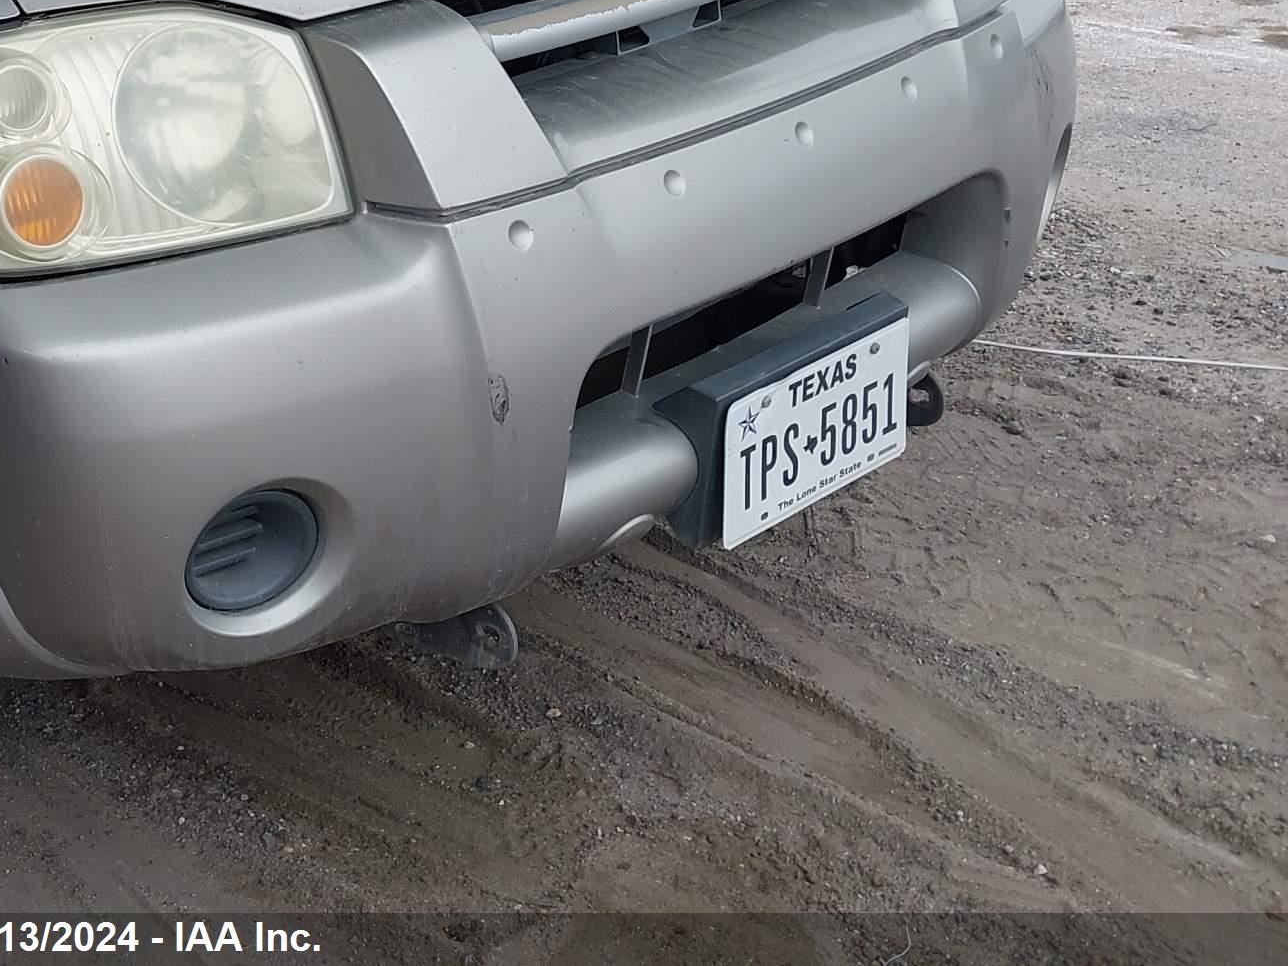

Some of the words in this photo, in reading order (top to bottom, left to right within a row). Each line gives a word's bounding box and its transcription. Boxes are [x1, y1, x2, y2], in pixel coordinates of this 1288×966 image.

[788, 353, 858, 408] TEXAS
[778, 498, 794, 512] The
[796, 485, 817, 501] Lone
[819, 473, 837, 489] Star
[839, 461, 861, 478] State
